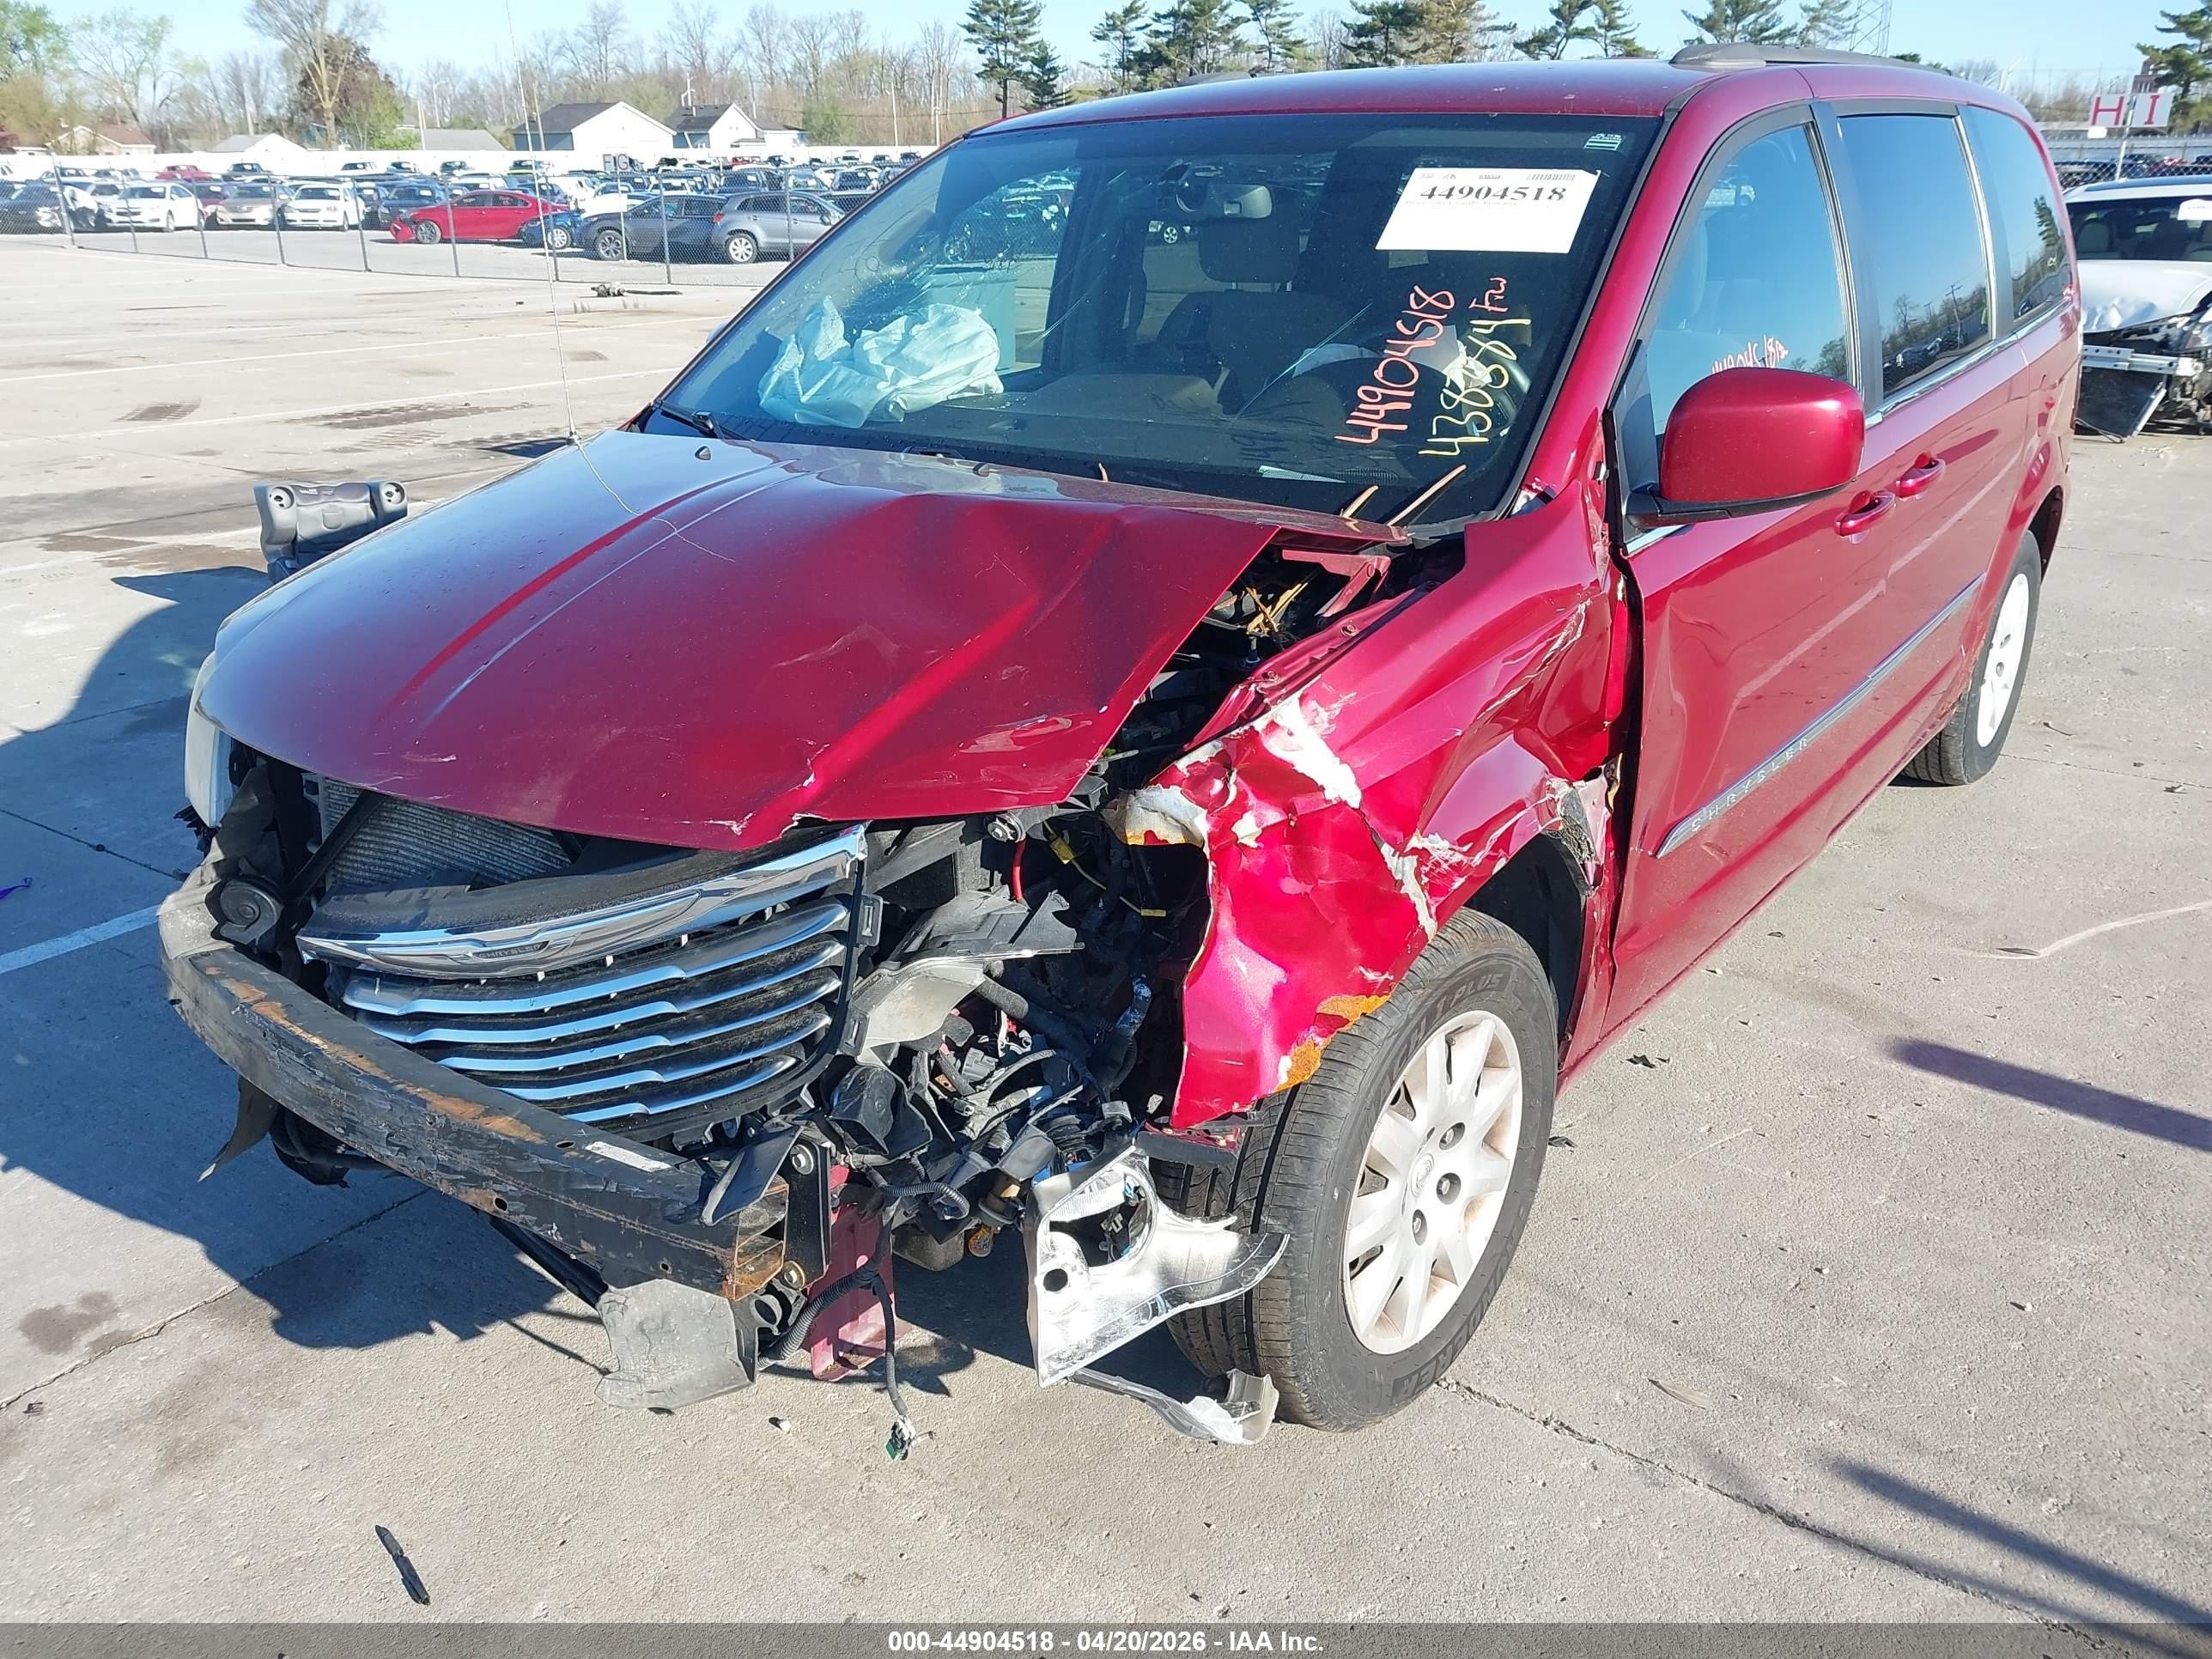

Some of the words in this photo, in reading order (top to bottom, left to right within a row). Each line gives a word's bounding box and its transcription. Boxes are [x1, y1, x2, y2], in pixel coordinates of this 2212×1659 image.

[2092, 96, 2124, 125] H
[1420, 185, 1567, 201] 44904518
[1334, 285, 1455, 444] 44904518
[1692, 738, 1808, 832] CHRYSLER
[479, 945, 542, 959] CHRYSLER
